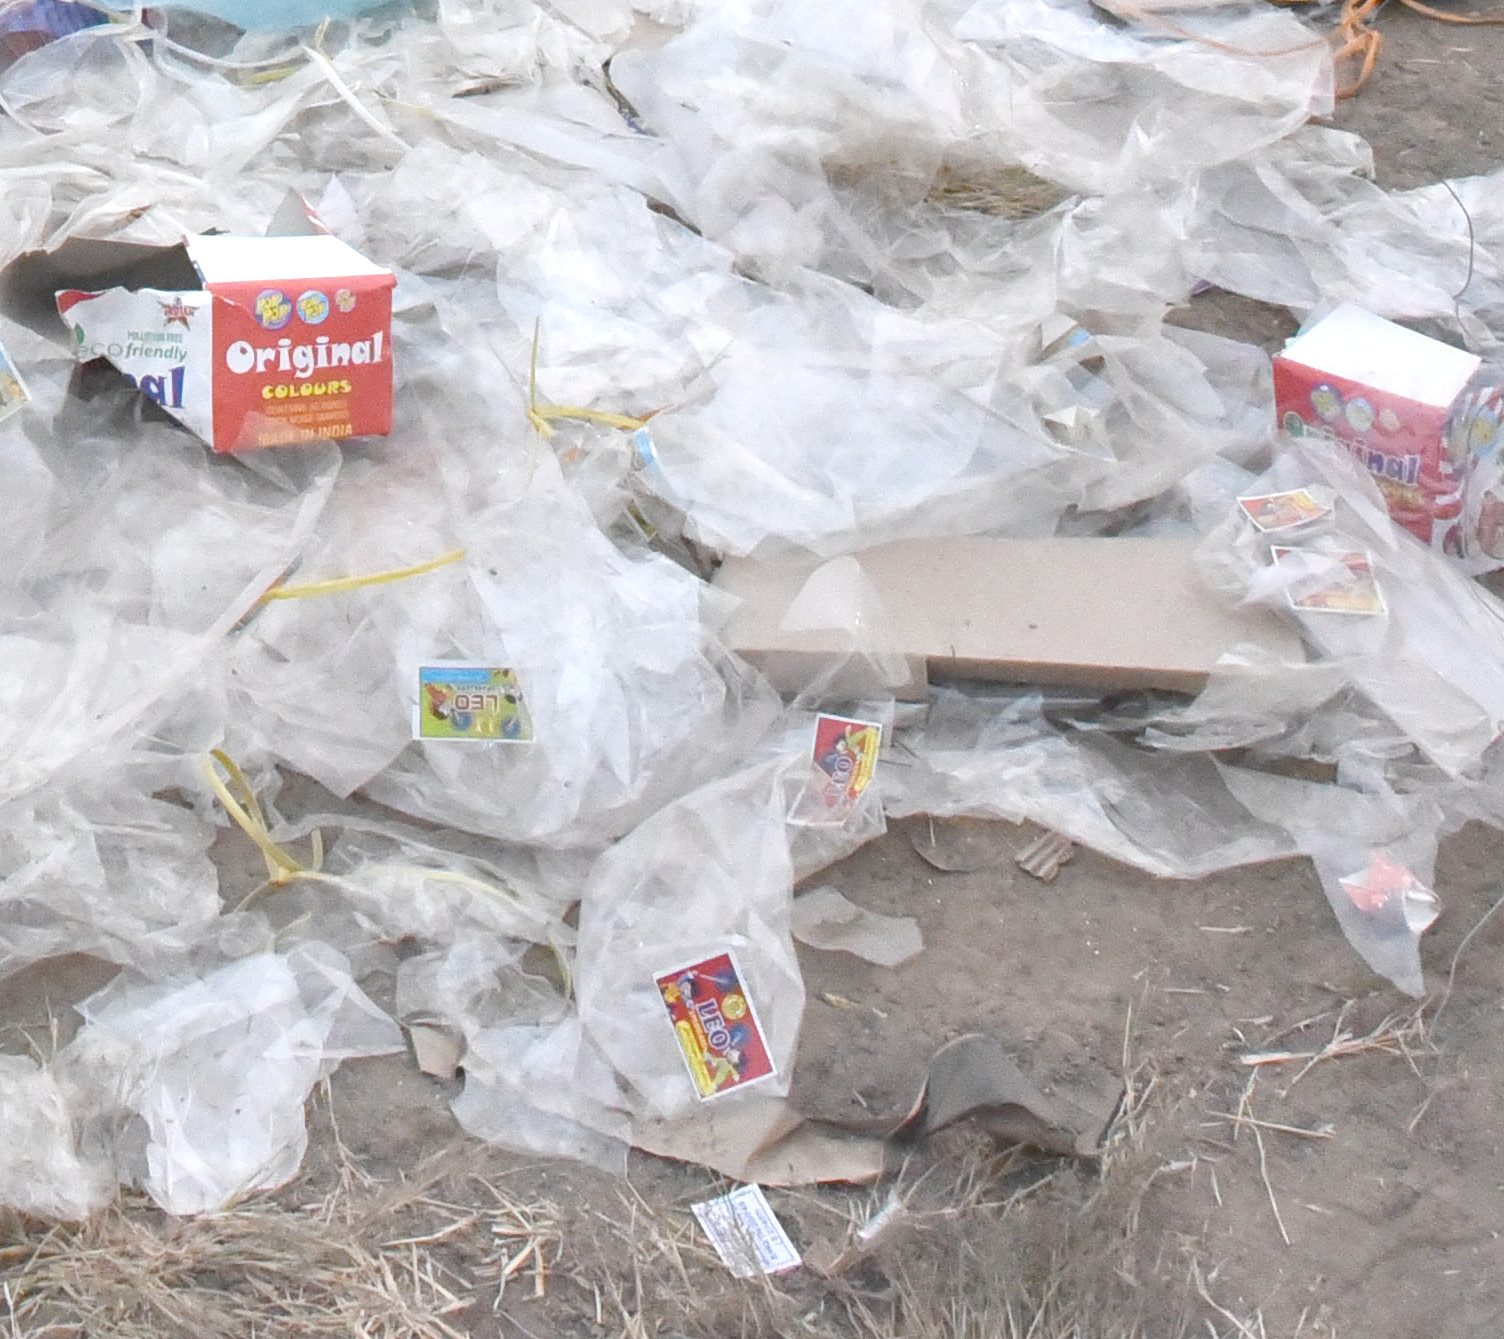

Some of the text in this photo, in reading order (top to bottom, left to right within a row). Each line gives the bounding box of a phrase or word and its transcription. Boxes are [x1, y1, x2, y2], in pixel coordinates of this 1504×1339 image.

[124, 341, 187, 361] friendly
[226, 331, 384, 379] Original
[262, 379, 352, 399] COLOURS
[319, 423, 353, 439] INDIA
[453, 692, 500, 715] LEO
[696, 997, 731, 1051] LEO
